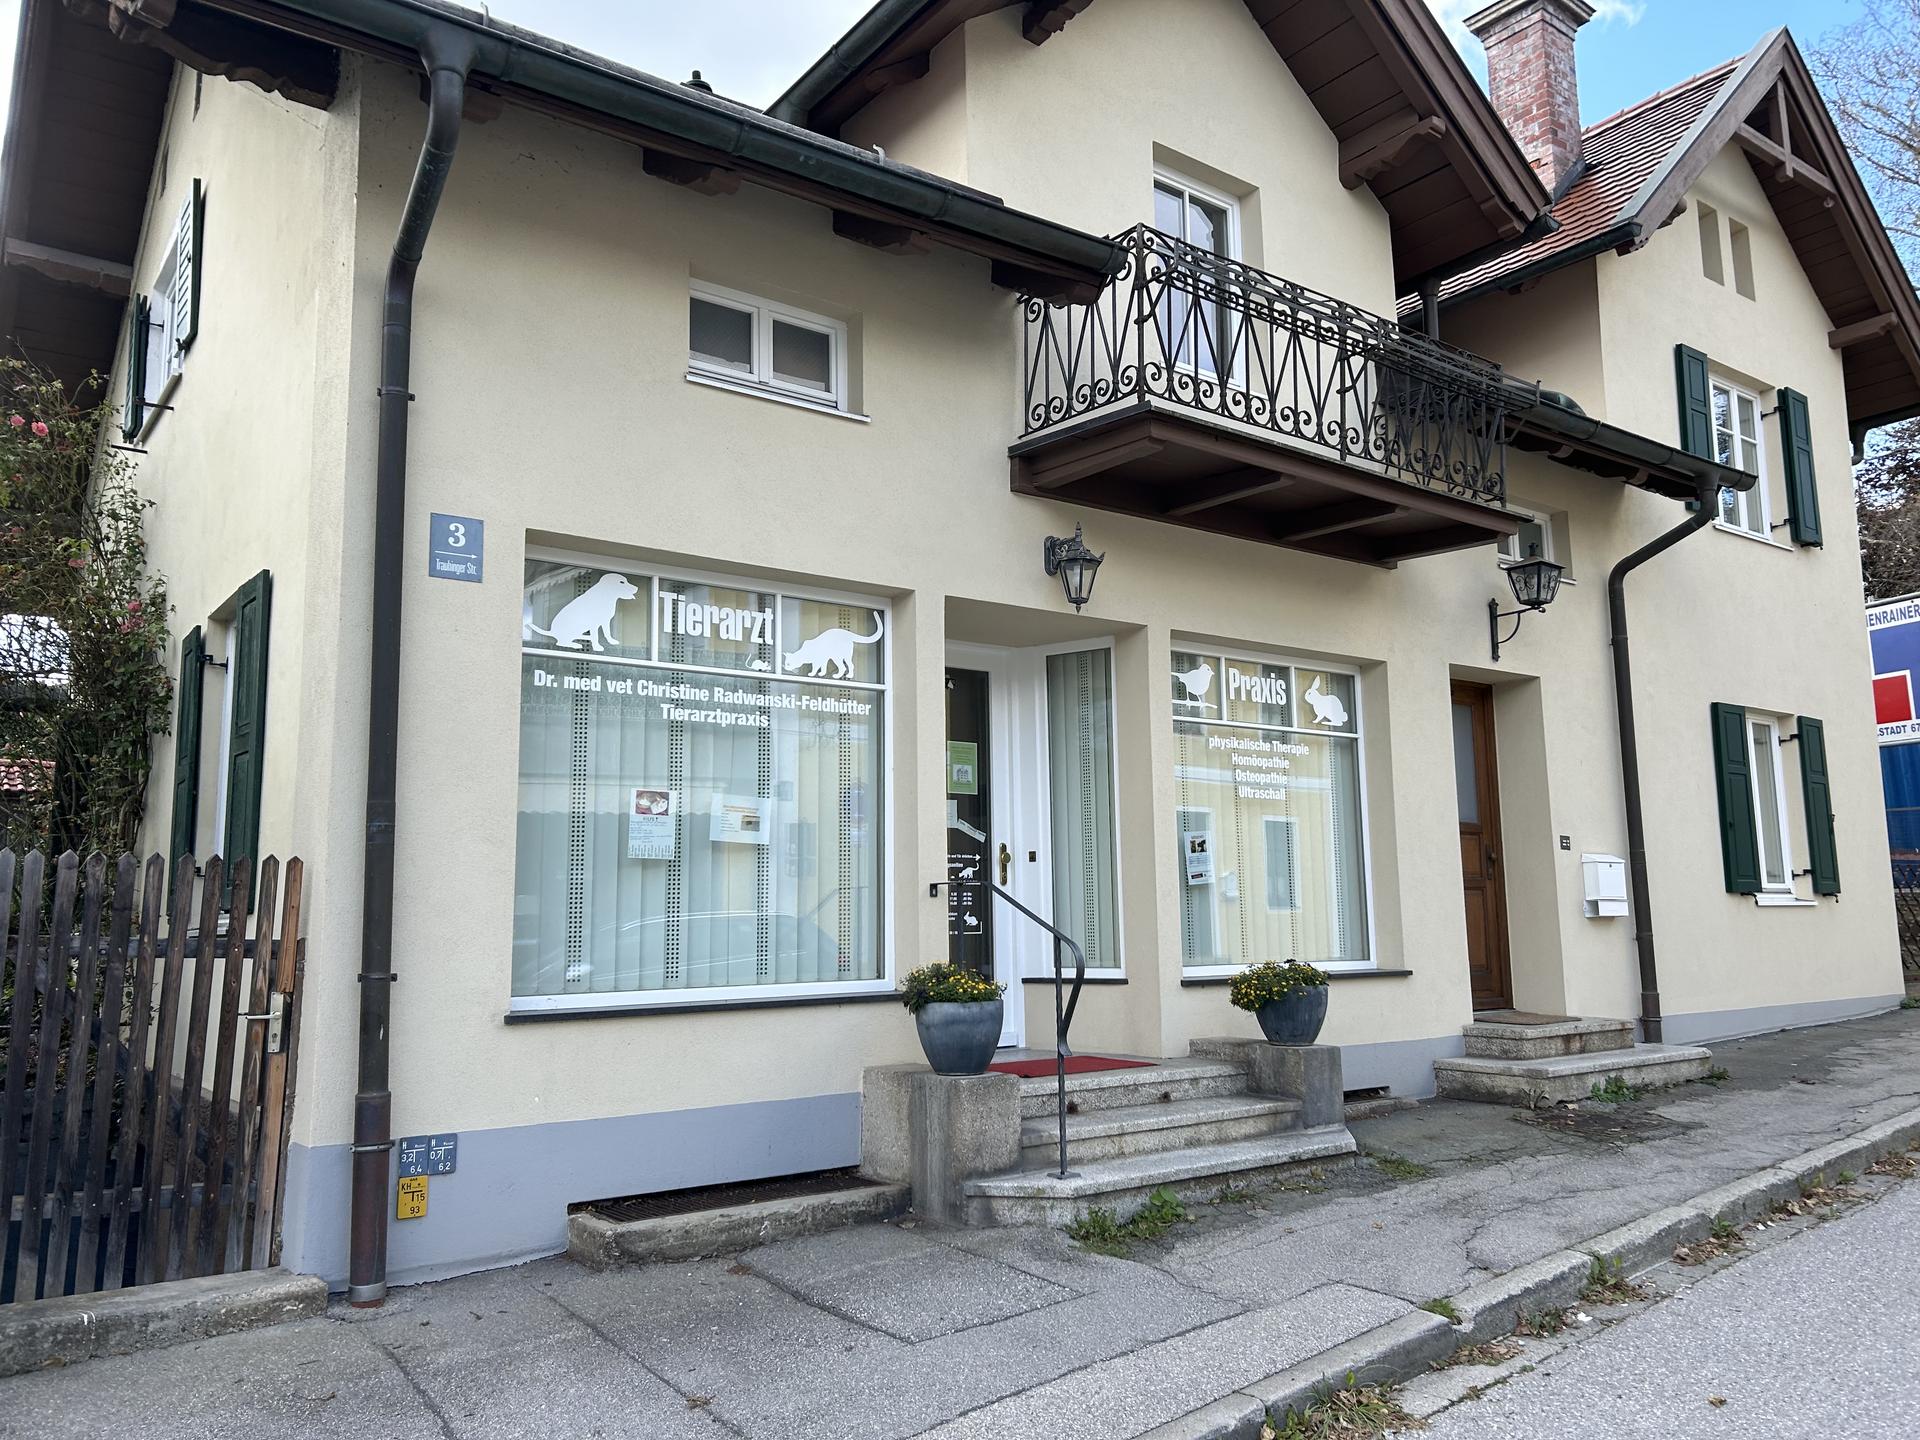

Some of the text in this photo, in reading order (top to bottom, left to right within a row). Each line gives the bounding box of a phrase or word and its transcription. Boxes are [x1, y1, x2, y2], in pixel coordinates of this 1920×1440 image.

[447, 522, 466, 547] 3
[658, 591, 774, 646] Tierarzt
[533, 669, 872, 716] Dr. med vet Christine Radwanski-Feldhütter
[1228, 667, 1287, 706] Praxis
[660, 703, 770, 728] Tierarztpraxis
[1877, 725, 1907, 737] STADT
[1208, 735, 1310, 757] physikalische Therapie
[1231, 752, 1290, 769] Homöopathie
[1235, 769, 1288, 785] Osteopathie
[1238, 785, 1286, 800] Ultraschall
[402, 1141, 407, 1150] H
[431, 1139, 436, 1147] H
[401, 1153, 414, 1163] 3,2
[410, 1164, 422, 1175] 6,4
[438, 1162, 451, 1172] 6,2
[401, 1183, 412, 1192] KH
